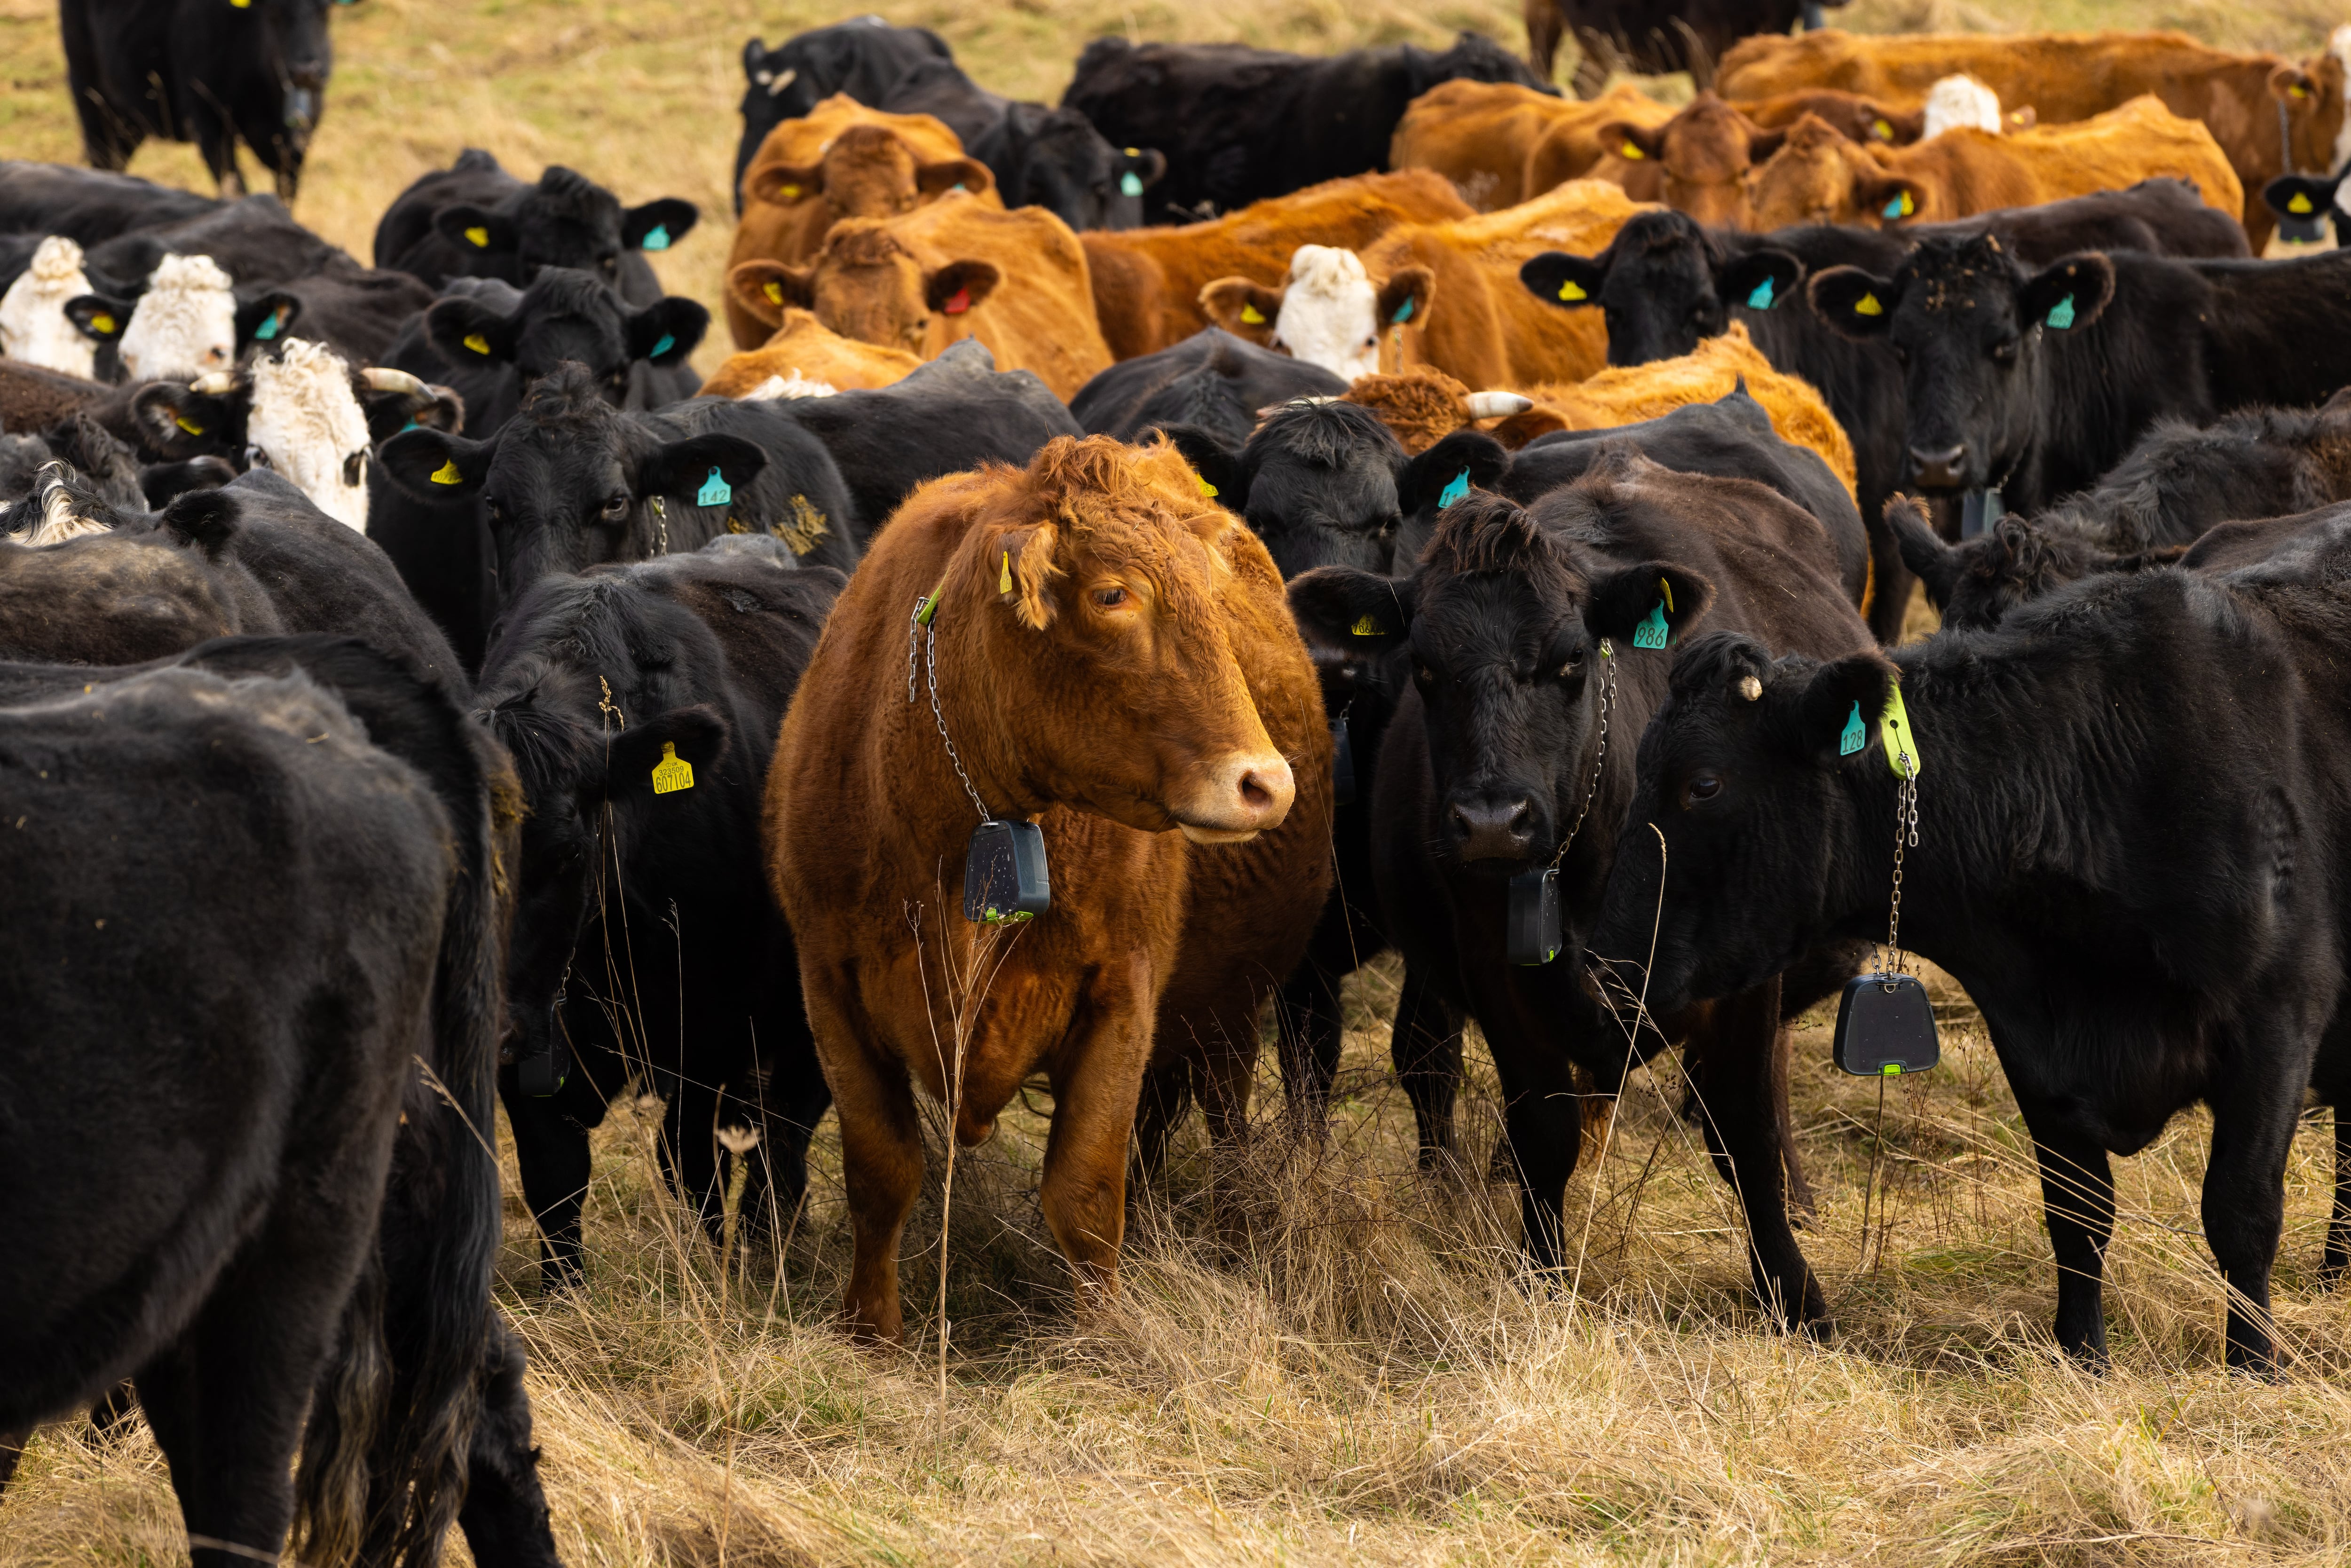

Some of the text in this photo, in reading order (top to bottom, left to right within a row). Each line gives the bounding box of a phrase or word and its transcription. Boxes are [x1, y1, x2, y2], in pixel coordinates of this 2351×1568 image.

[701, 489, 727, 504] 142
[1636, 627, 1665, 647] 986
[1842, 730, 1862, 753] 128
[659, 766, 684, 776] 323509
[656, 771, 691, 793] 607104
